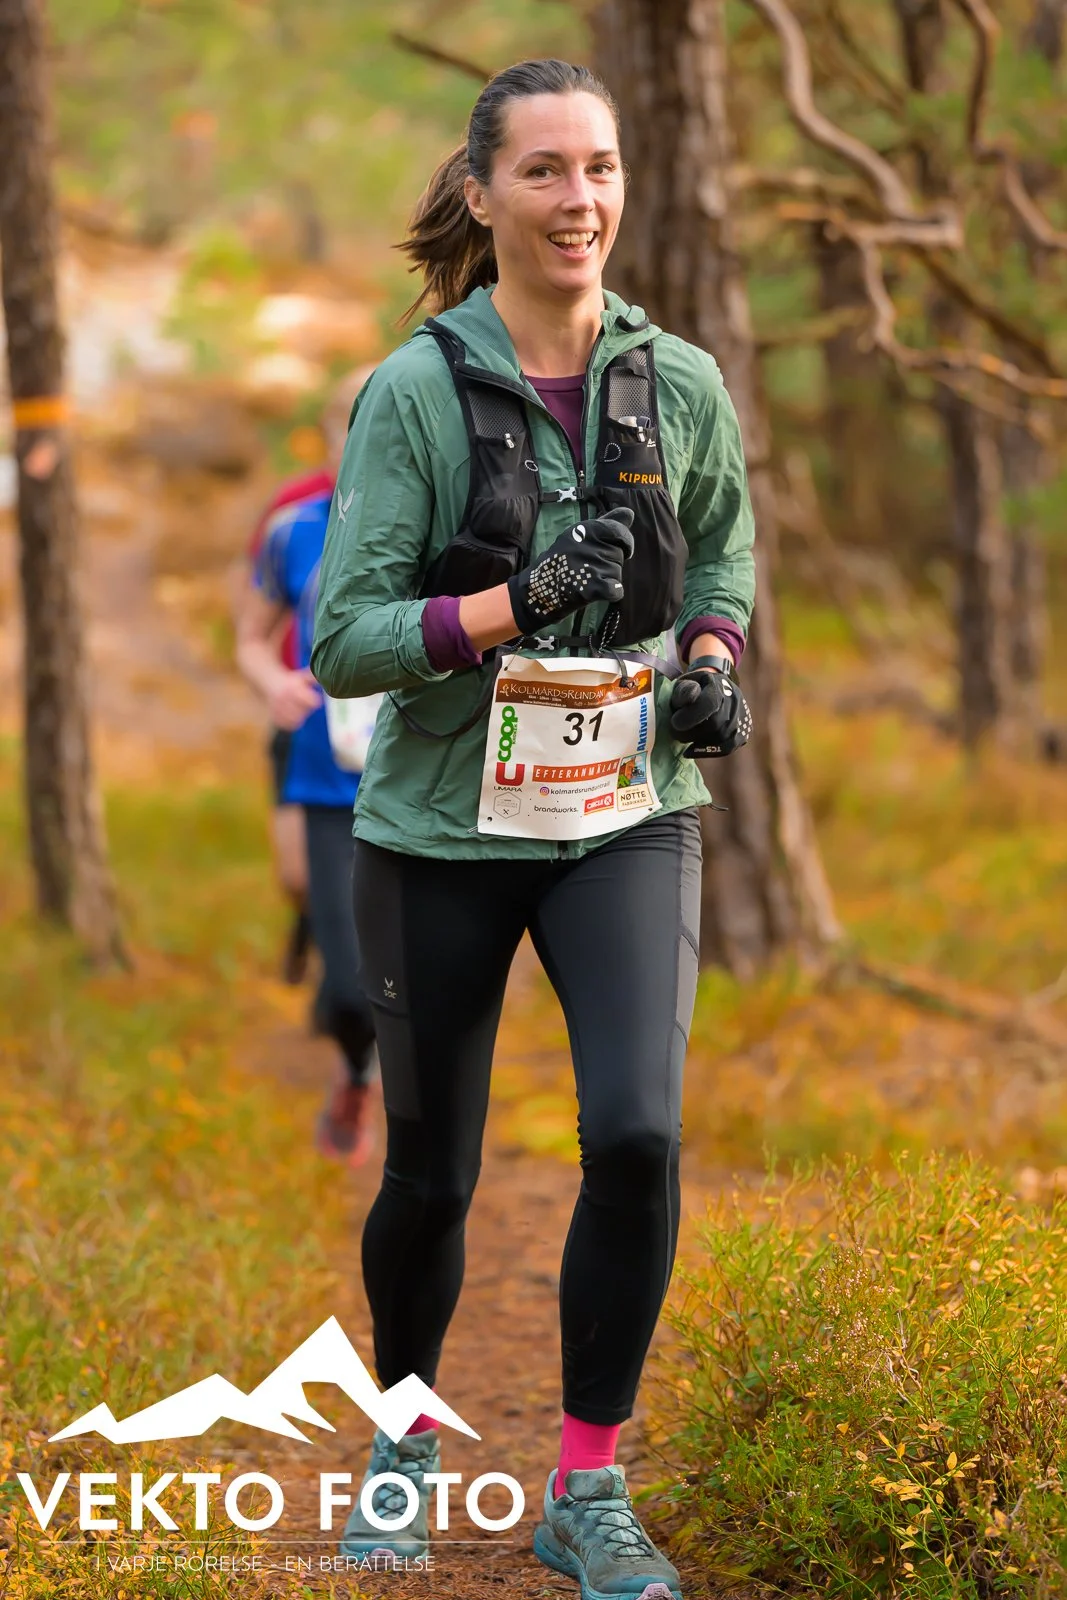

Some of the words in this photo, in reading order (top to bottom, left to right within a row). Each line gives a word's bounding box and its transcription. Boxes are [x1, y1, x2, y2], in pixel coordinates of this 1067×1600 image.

[619, 472, 662, 484] KIPRUN
[498, 705, 518, 762] coop
[563, 710, 604, 746] 31
[637, 697, 647, 751] Aktivitus
[535, 761, 619, 779] EFTERANMÄLAN
[620, 791, 646, 801] NØTTE
